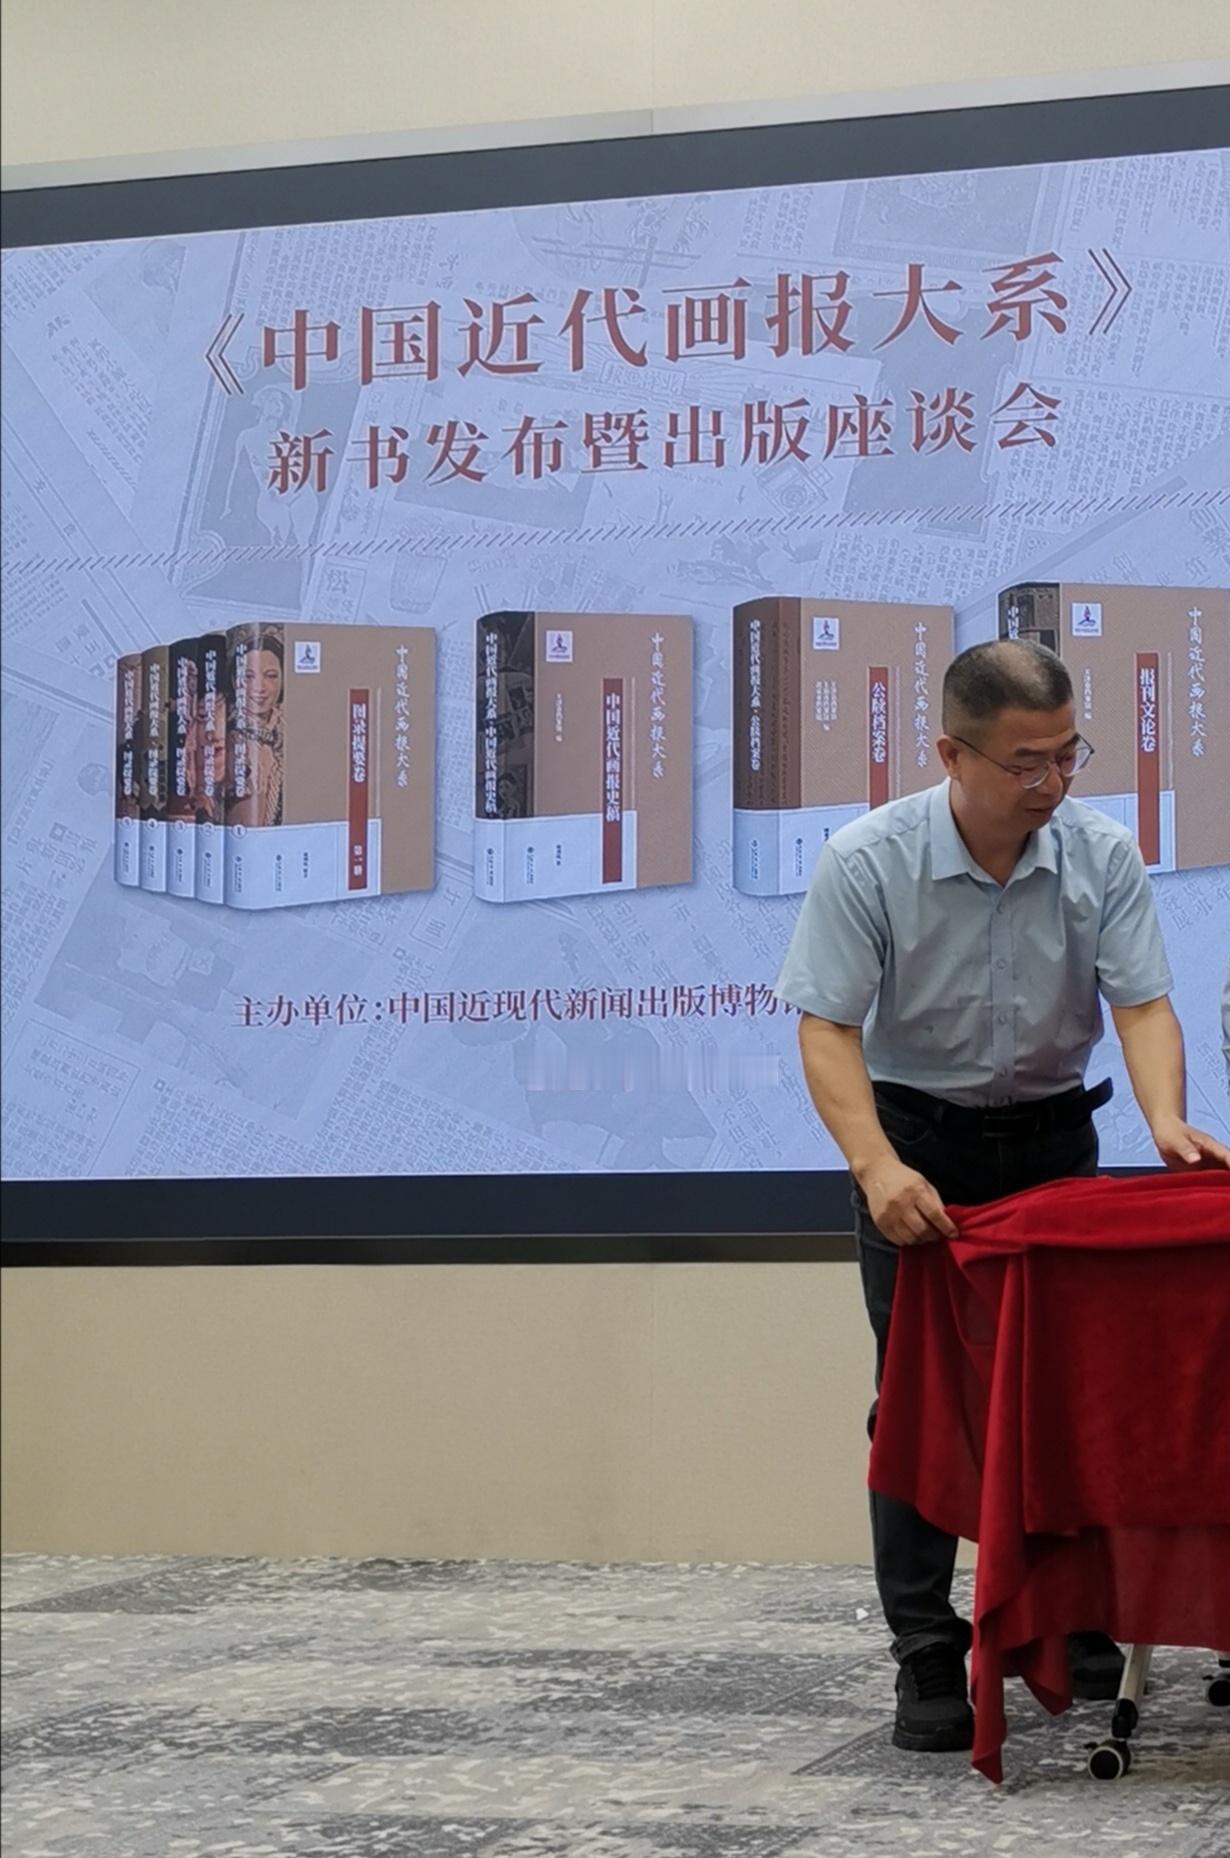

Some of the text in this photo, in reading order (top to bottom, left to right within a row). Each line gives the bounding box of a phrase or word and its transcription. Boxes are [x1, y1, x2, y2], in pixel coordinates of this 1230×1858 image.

[205, 247, 1132, 396] 《中国近代画报大系》
[266, 381, 1062, 495] 新书发布暨出版座谈会
[606, 693, 620, 823] 中国近代画报史稿
[1140, 668, 1157, 752] 报刊文论卷
